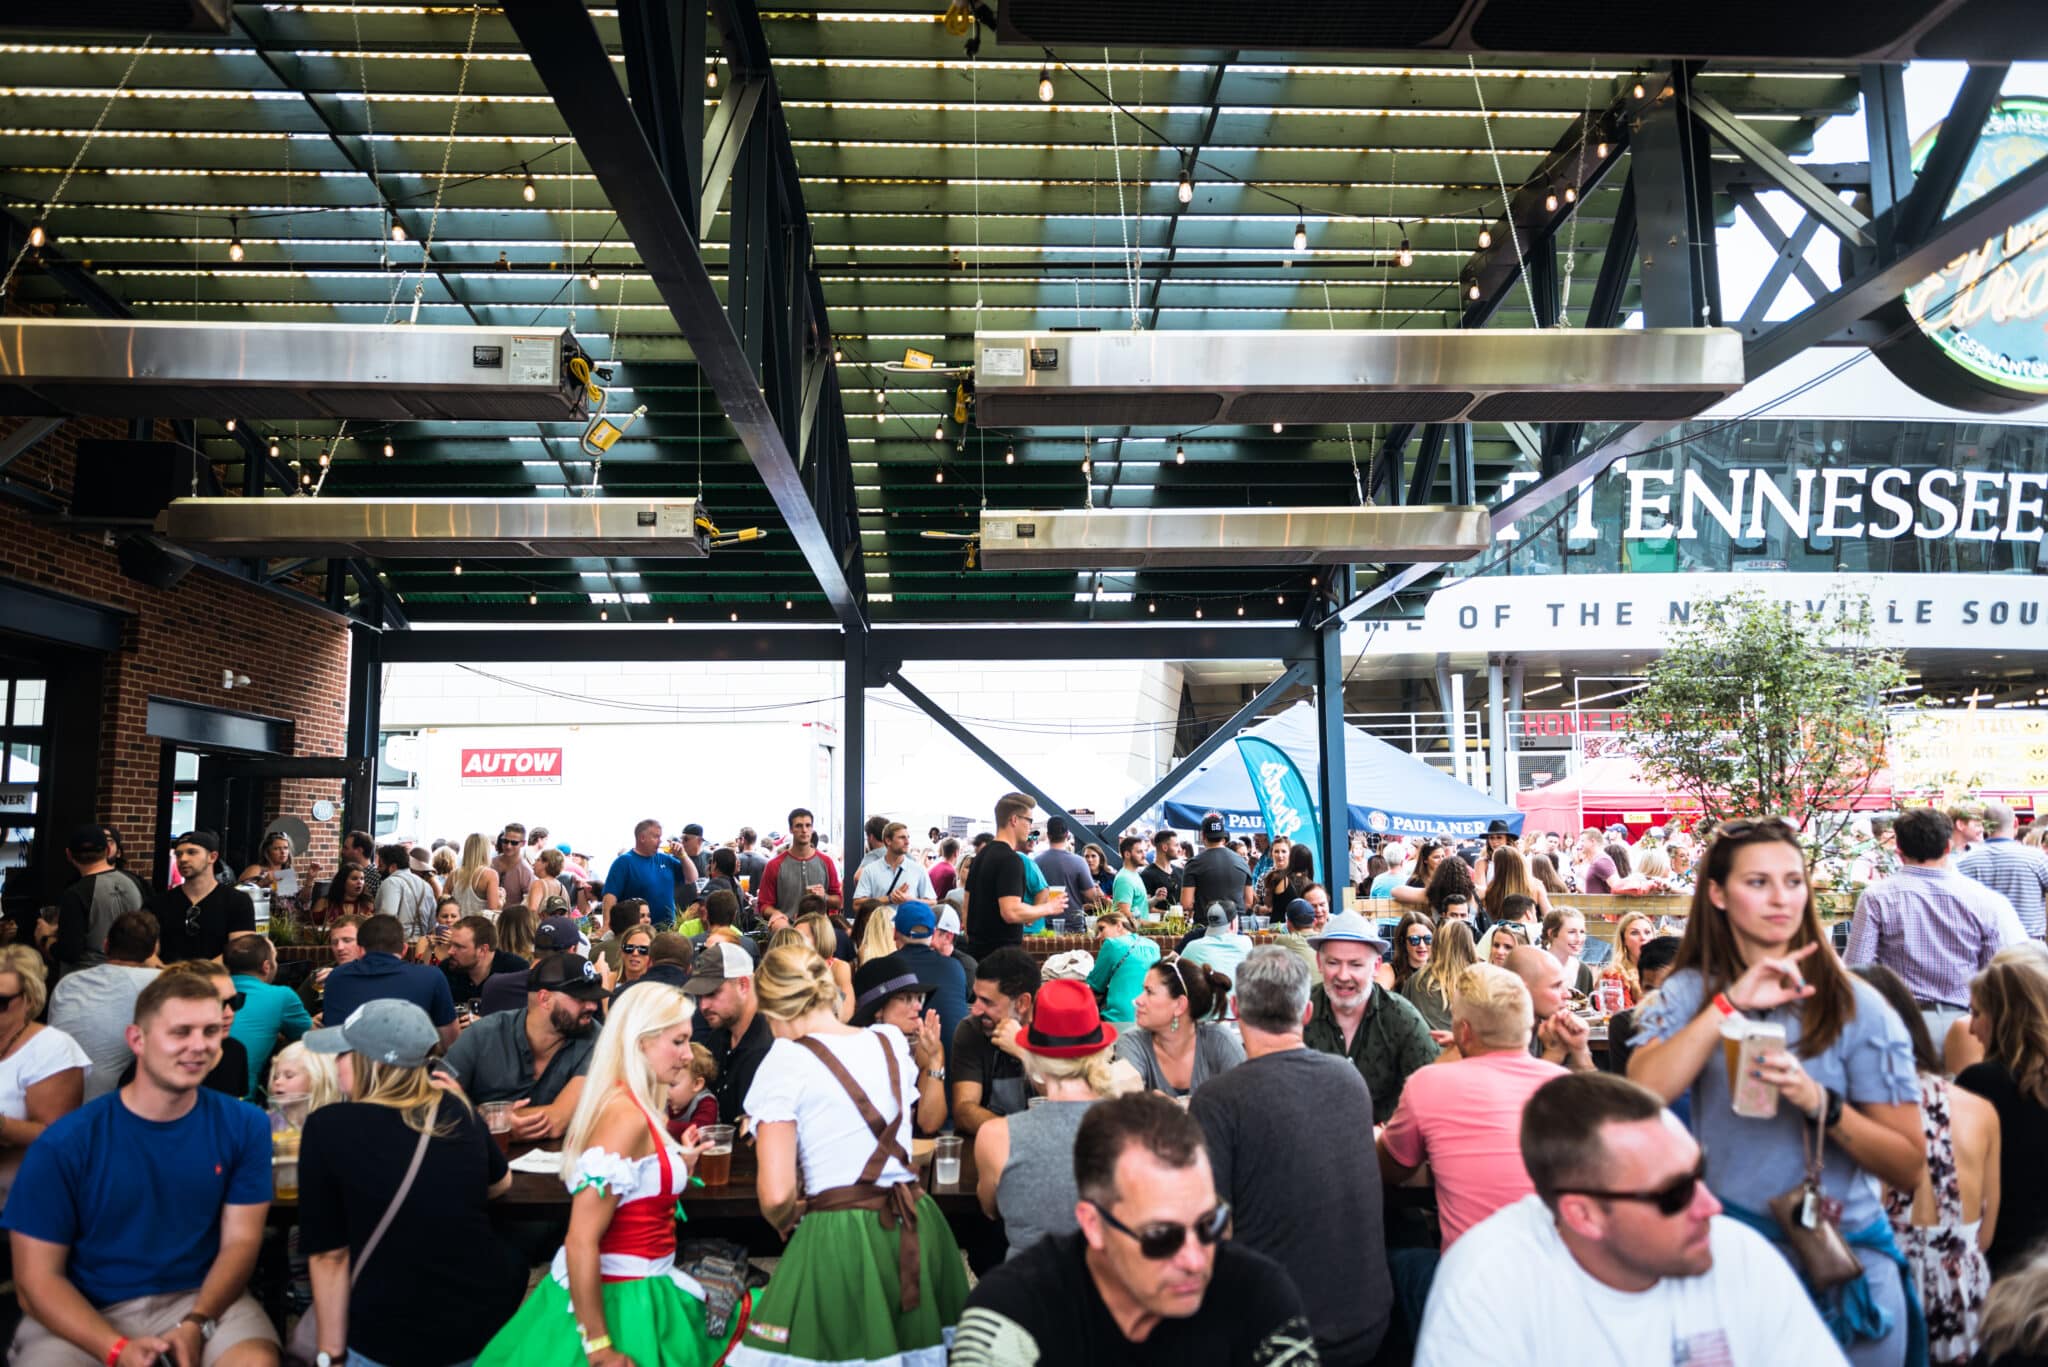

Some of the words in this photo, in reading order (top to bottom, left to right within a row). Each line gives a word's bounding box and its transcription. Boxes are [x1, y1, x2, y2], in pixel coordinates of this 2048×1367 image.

[1458, 605, 1511, 630] OF
[1546, 602, 1633, 627] THE
[1523, 712, 1602, 737] HOME
[463, 752, 558, 774] AUTOW
[1227, 814, 1267, 829] PAU
[1392, 815, 1488, 835] PAULANER
